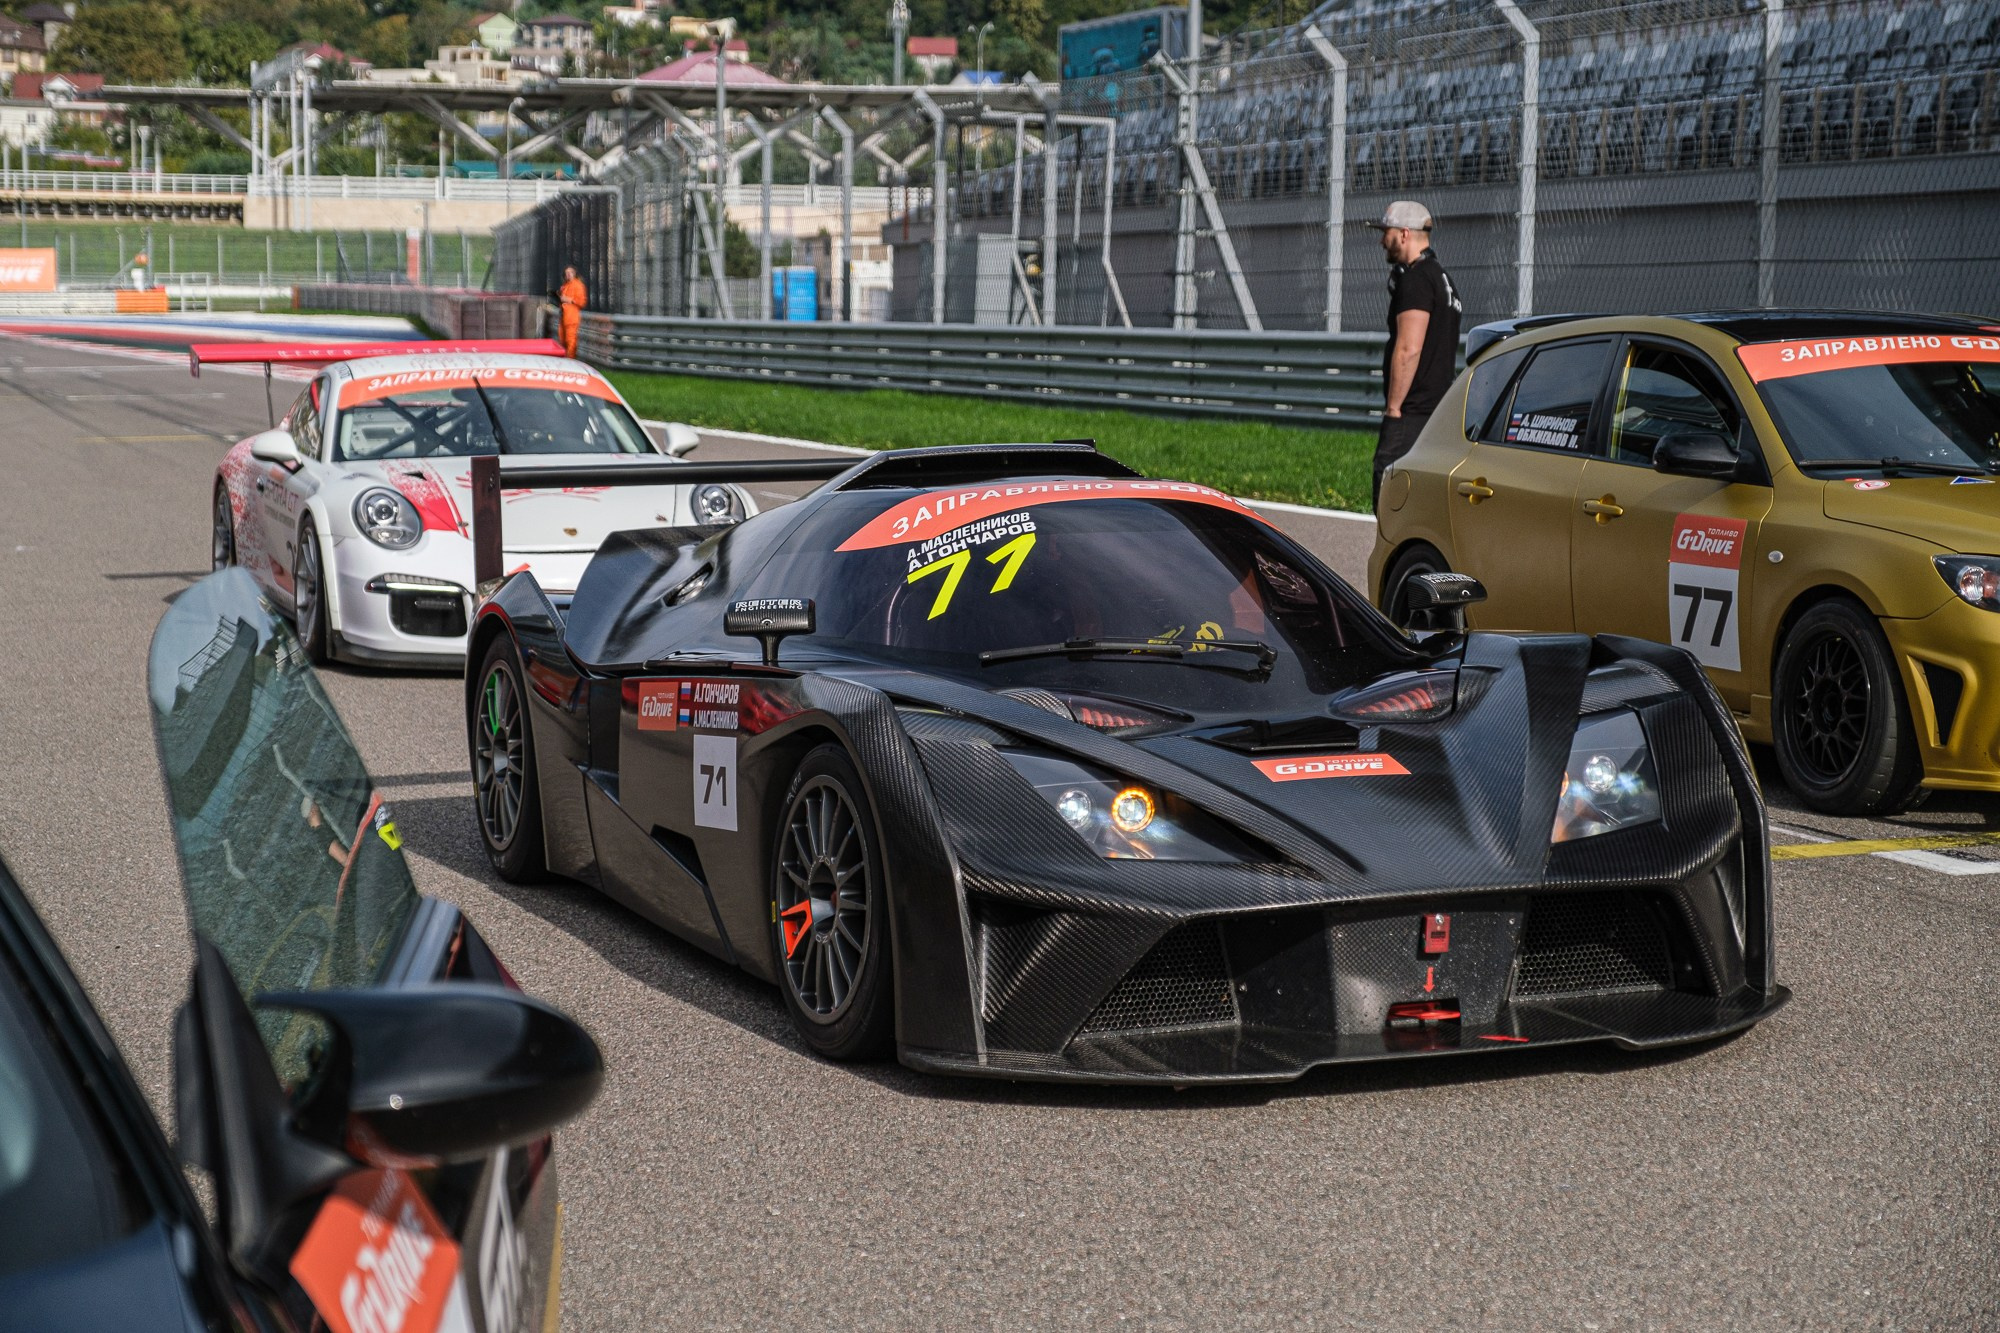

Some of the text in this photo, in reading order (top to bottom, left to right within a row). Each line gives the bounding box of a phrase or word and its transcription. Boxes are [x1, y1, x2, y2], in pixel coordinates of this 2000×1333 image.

[1781, 336, 1941, 362] ЗАПРАВЛЕНО
[368, 368, 496, 391] ЗАПРАВЛЕНО
[1530, 415, 1577, 432] ШИРИНОВ
[892, 483, 1114, 539] ЗАПРАВЛЕНО
[907, 512, 1030, 561] А.МАСЛЕННИКОВ
[908, 521, 1037, 573] А.ГОНЧАРОВ
[907, 532, 1036, 620] 71
[1674, 583, 1732, 647] 77
[693, 683, 740, 704] А.ГОНЧАРОВ
[700, 764, 728, 806] 71
[1275, 761, 1384, 775] G-DRIVE
